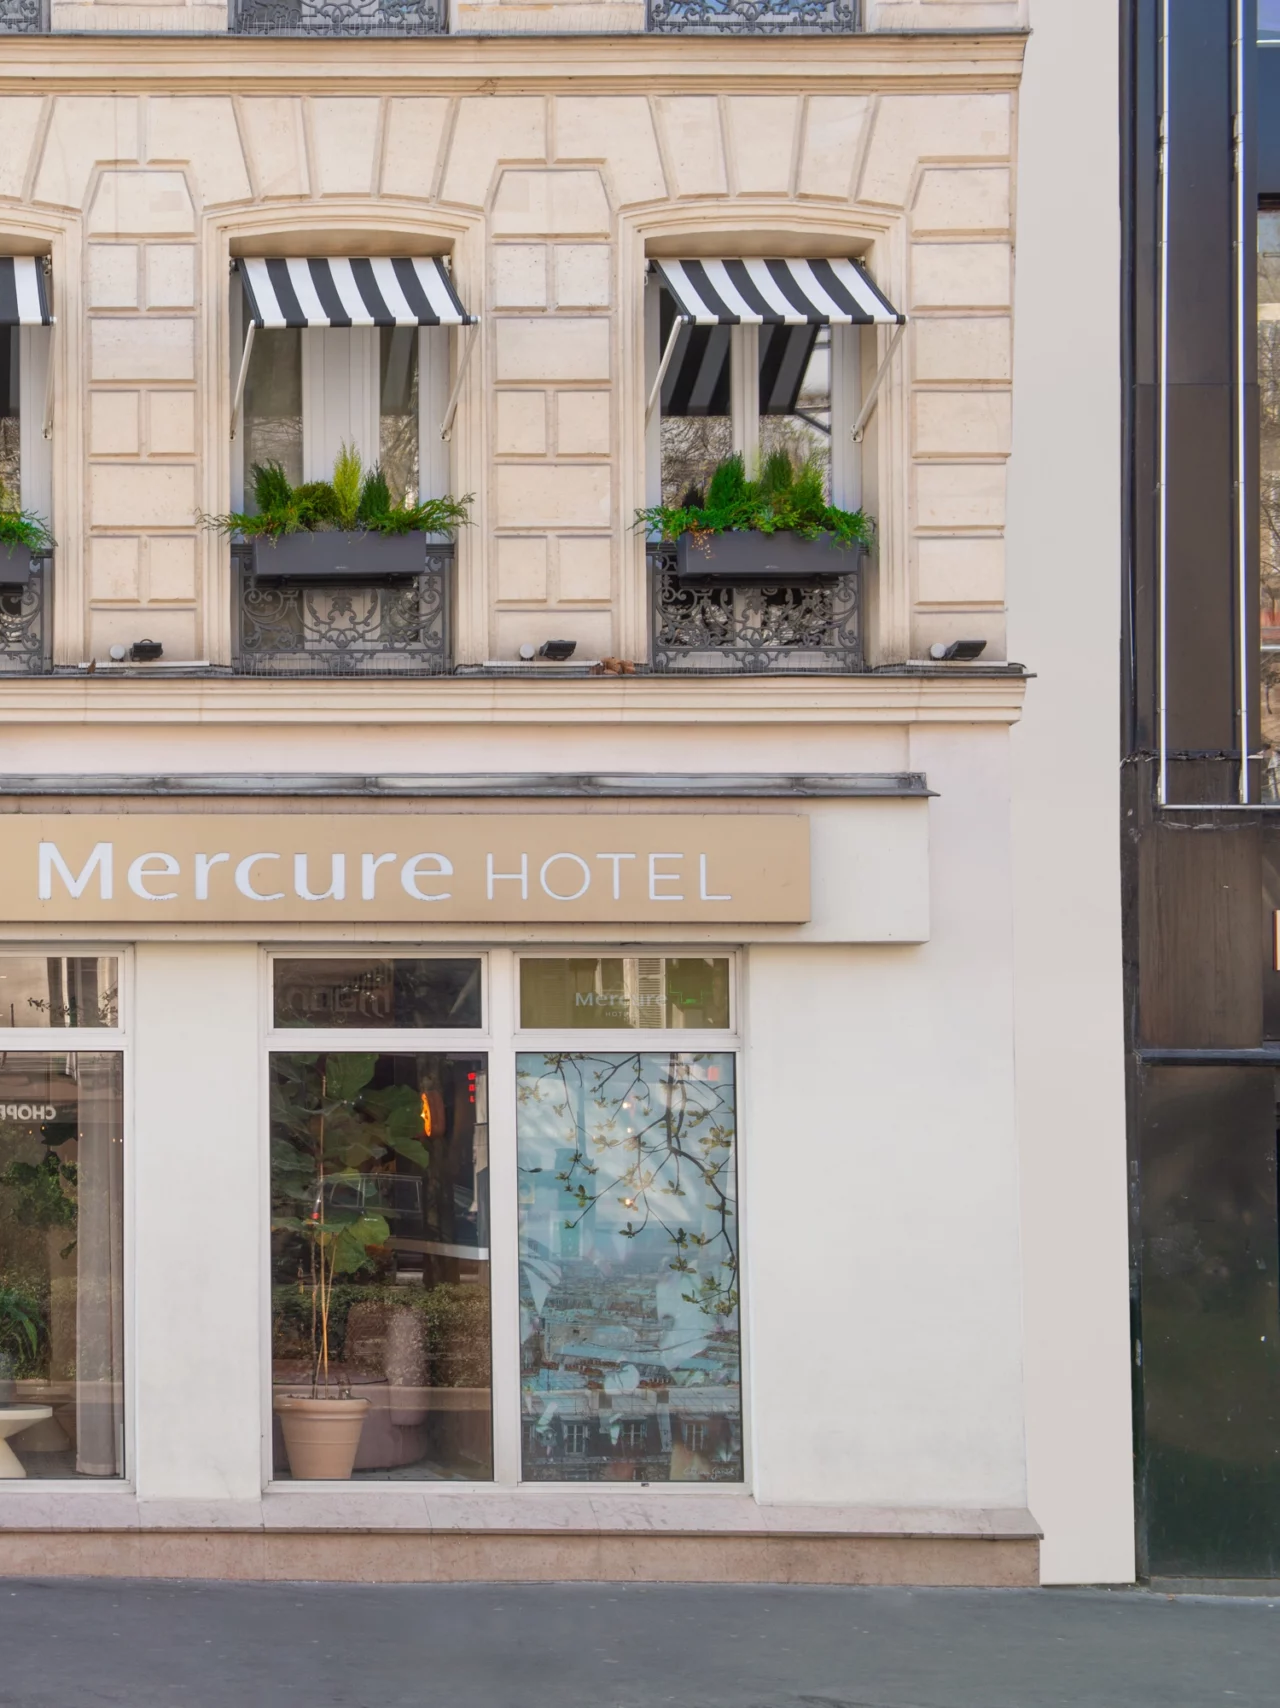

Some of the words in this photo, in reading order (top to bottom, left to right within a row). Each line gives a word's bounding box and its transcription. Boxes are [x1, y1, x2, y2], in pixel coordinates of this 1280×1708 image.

[38, 842, 454, 901] Mercure
[487, 852, 732, 901] HOTEL
[575, 991, 668, 1007] Mercure
